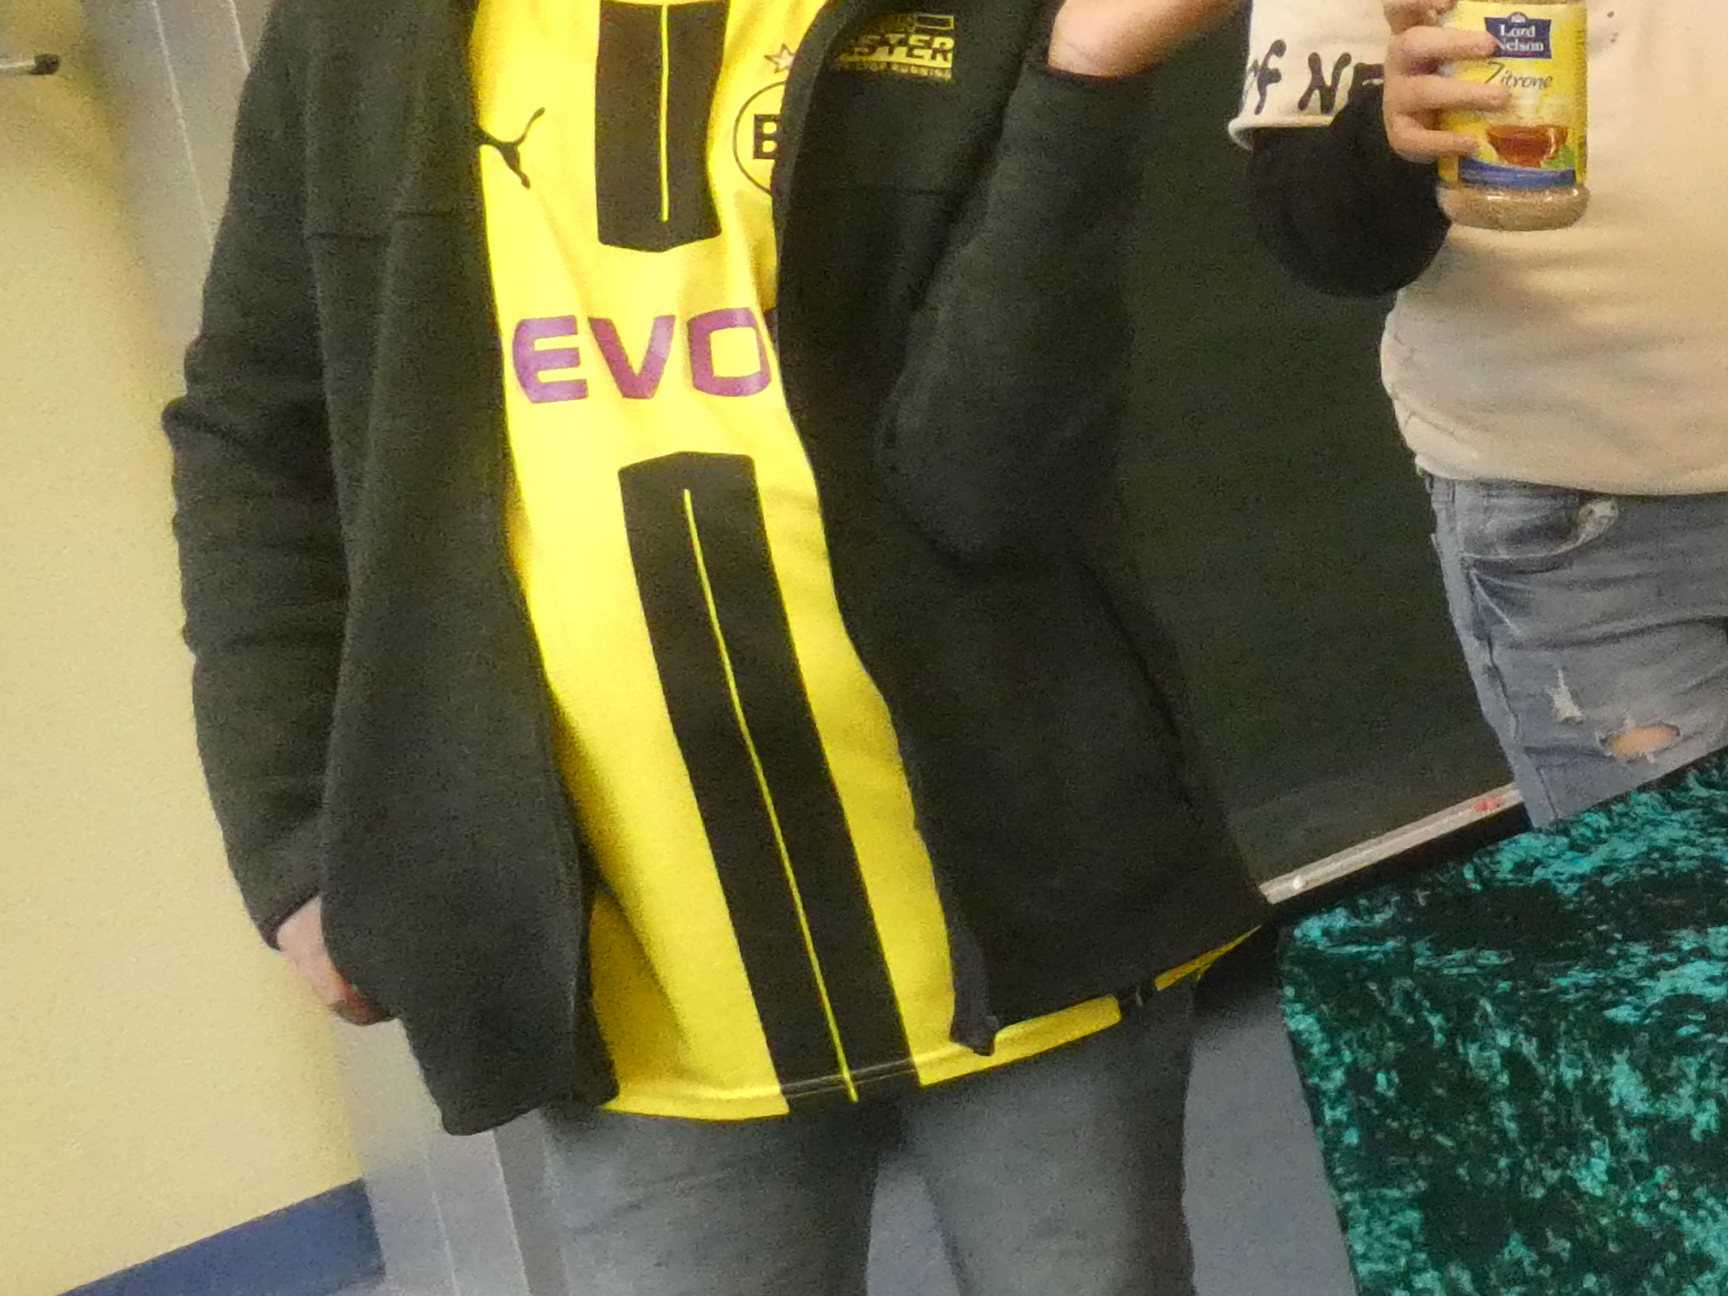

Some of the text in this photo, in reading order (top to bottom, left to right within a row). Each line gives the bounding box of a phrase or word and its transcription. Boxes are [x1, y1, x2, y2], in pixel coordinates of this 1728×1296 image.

[1500, 24, 1536, 38] Lord
[1486, 60, 1554, 89] Zitrone
[513, 307, 776, 404] EVO
